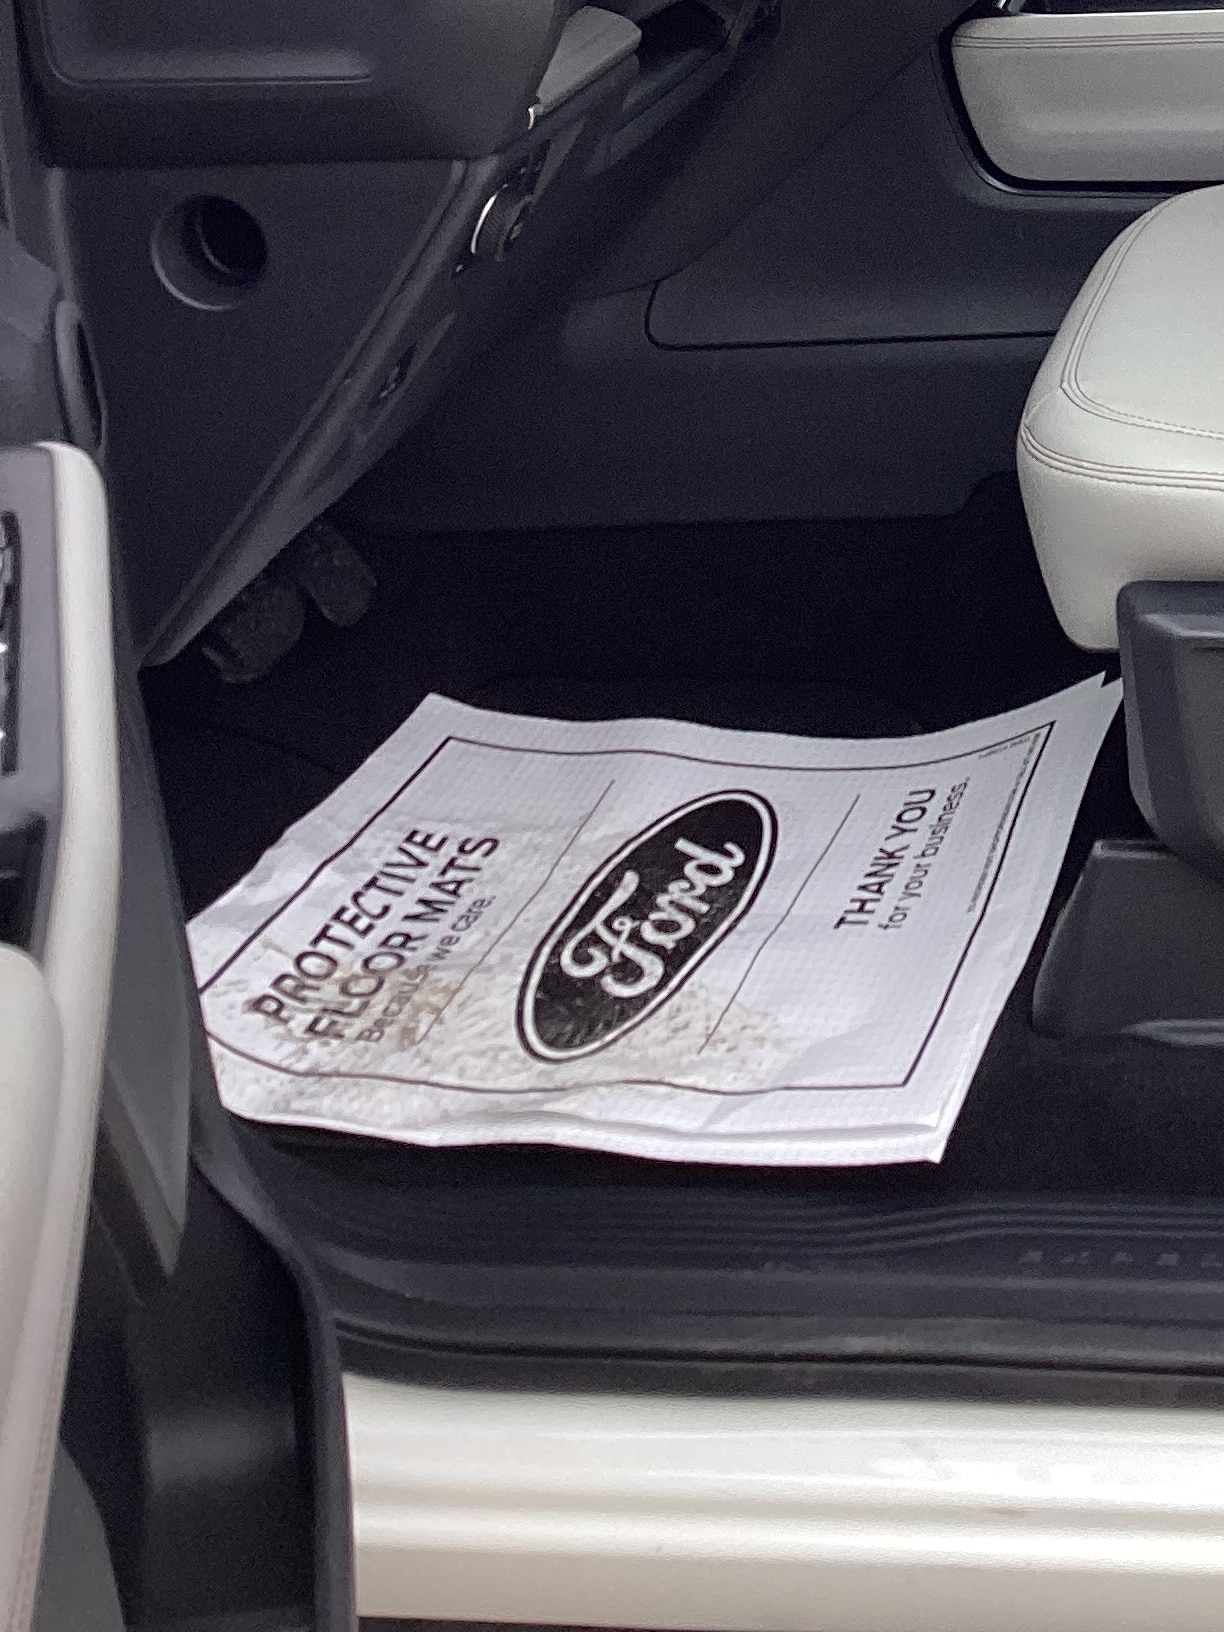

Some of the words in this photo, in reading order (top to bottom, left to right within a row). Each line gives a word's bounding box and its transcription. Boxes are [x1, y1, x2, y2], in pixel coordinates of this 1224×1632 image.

[834, 844, 910, 930] THANK
[885, 788, 936, 842] YOU
[900, 862, 932, 902] your
[912, 776, 971, 860] business.
[249, 828, 449, 1023] PROTECTIVE
[303, 930, 429, 1040] FLOOR
[401, 836, 499, 923] MATS
[354, 964, 430, 1043] Becaus
[426, 934, 461, 961] we
[450, 895, 497, 932] care.
[878, 905, 911, 930] for
